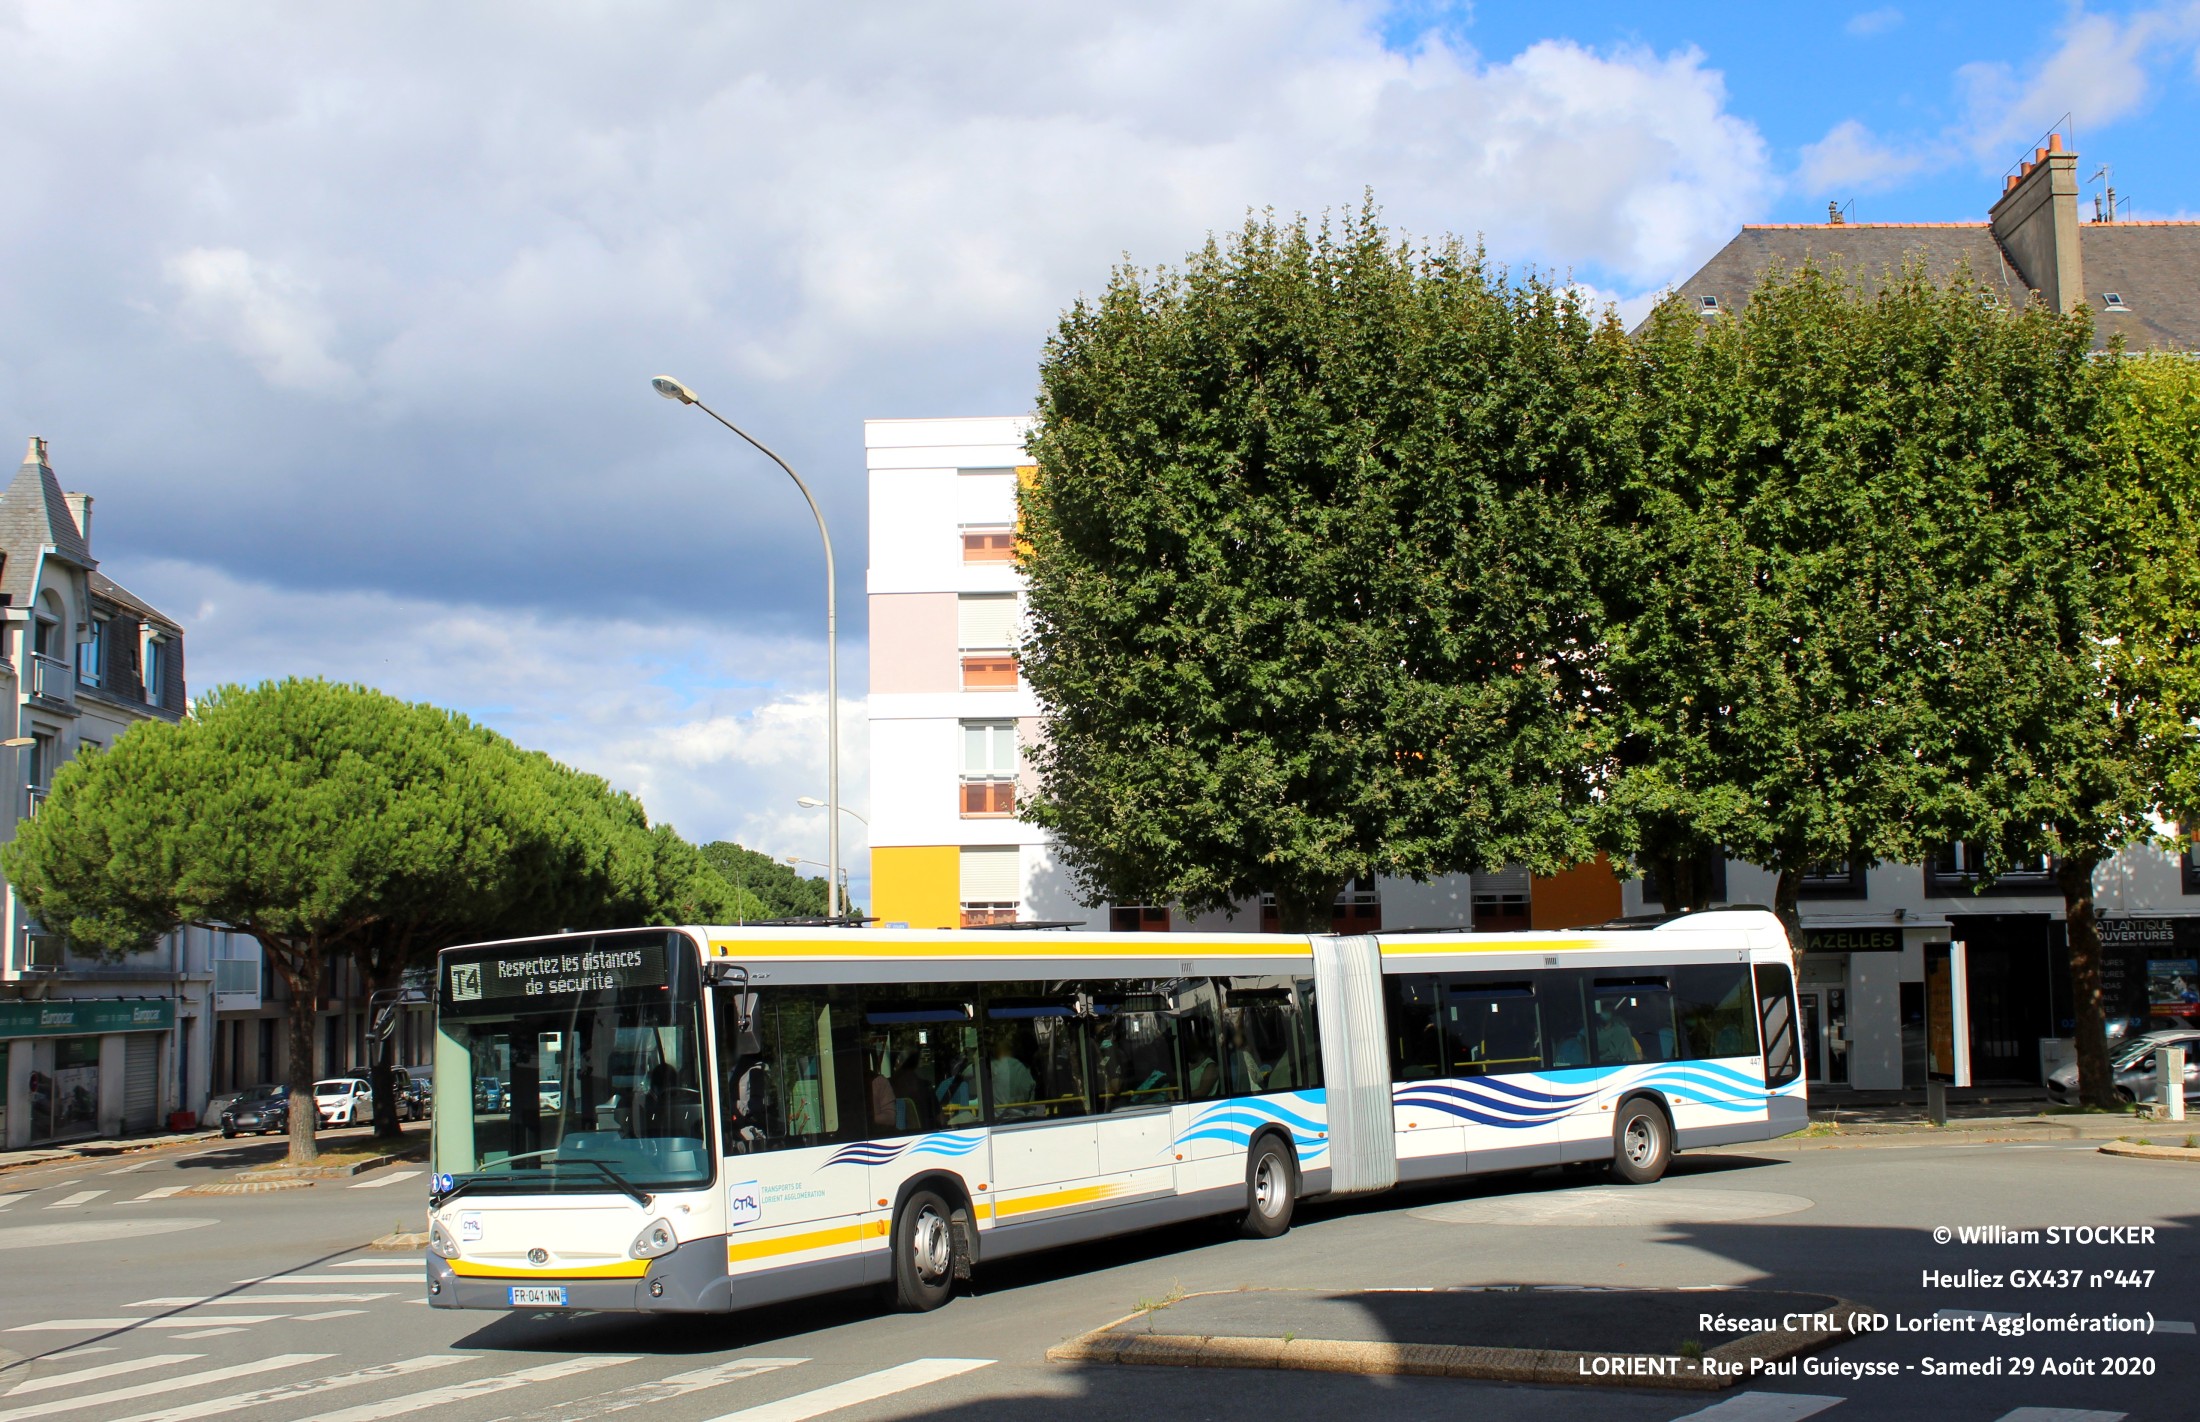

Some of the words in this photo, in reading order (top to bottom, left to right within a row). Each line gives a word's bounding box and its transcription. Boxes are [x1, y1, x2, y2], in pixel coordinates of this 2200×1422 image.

[2096, 920, 2173, 931] ATLANTIQUE
[2097, 931, 2175, 941] OUVERTURES
[498, 957, 559, 979] Respectez
[562, 955, 580, 973] les
[582, 950, 642, 971] distances
[452, 968, 479, 996] T4
[526, 978, 544, 996] de
[549, 972, 614, 994] sécurité
[41, 1009, 75, 1025] Europcar
[133, 1007, 161, 1022] Europcar
[1750, 1057, 1761, 1066] 447
[761, 1183, 795, 1194] TRANSPORTS
[795, 1182, 802, 1190] DE
[733, 1195, 757, 1210] CTRL
[761, 1195, 783, 1204] LORIENT
[441, 1213, 452, 1221] 447
[463, 1221, 480, 1231] CTRL
[514, 1289, 560, 1303] FR-041-NN
